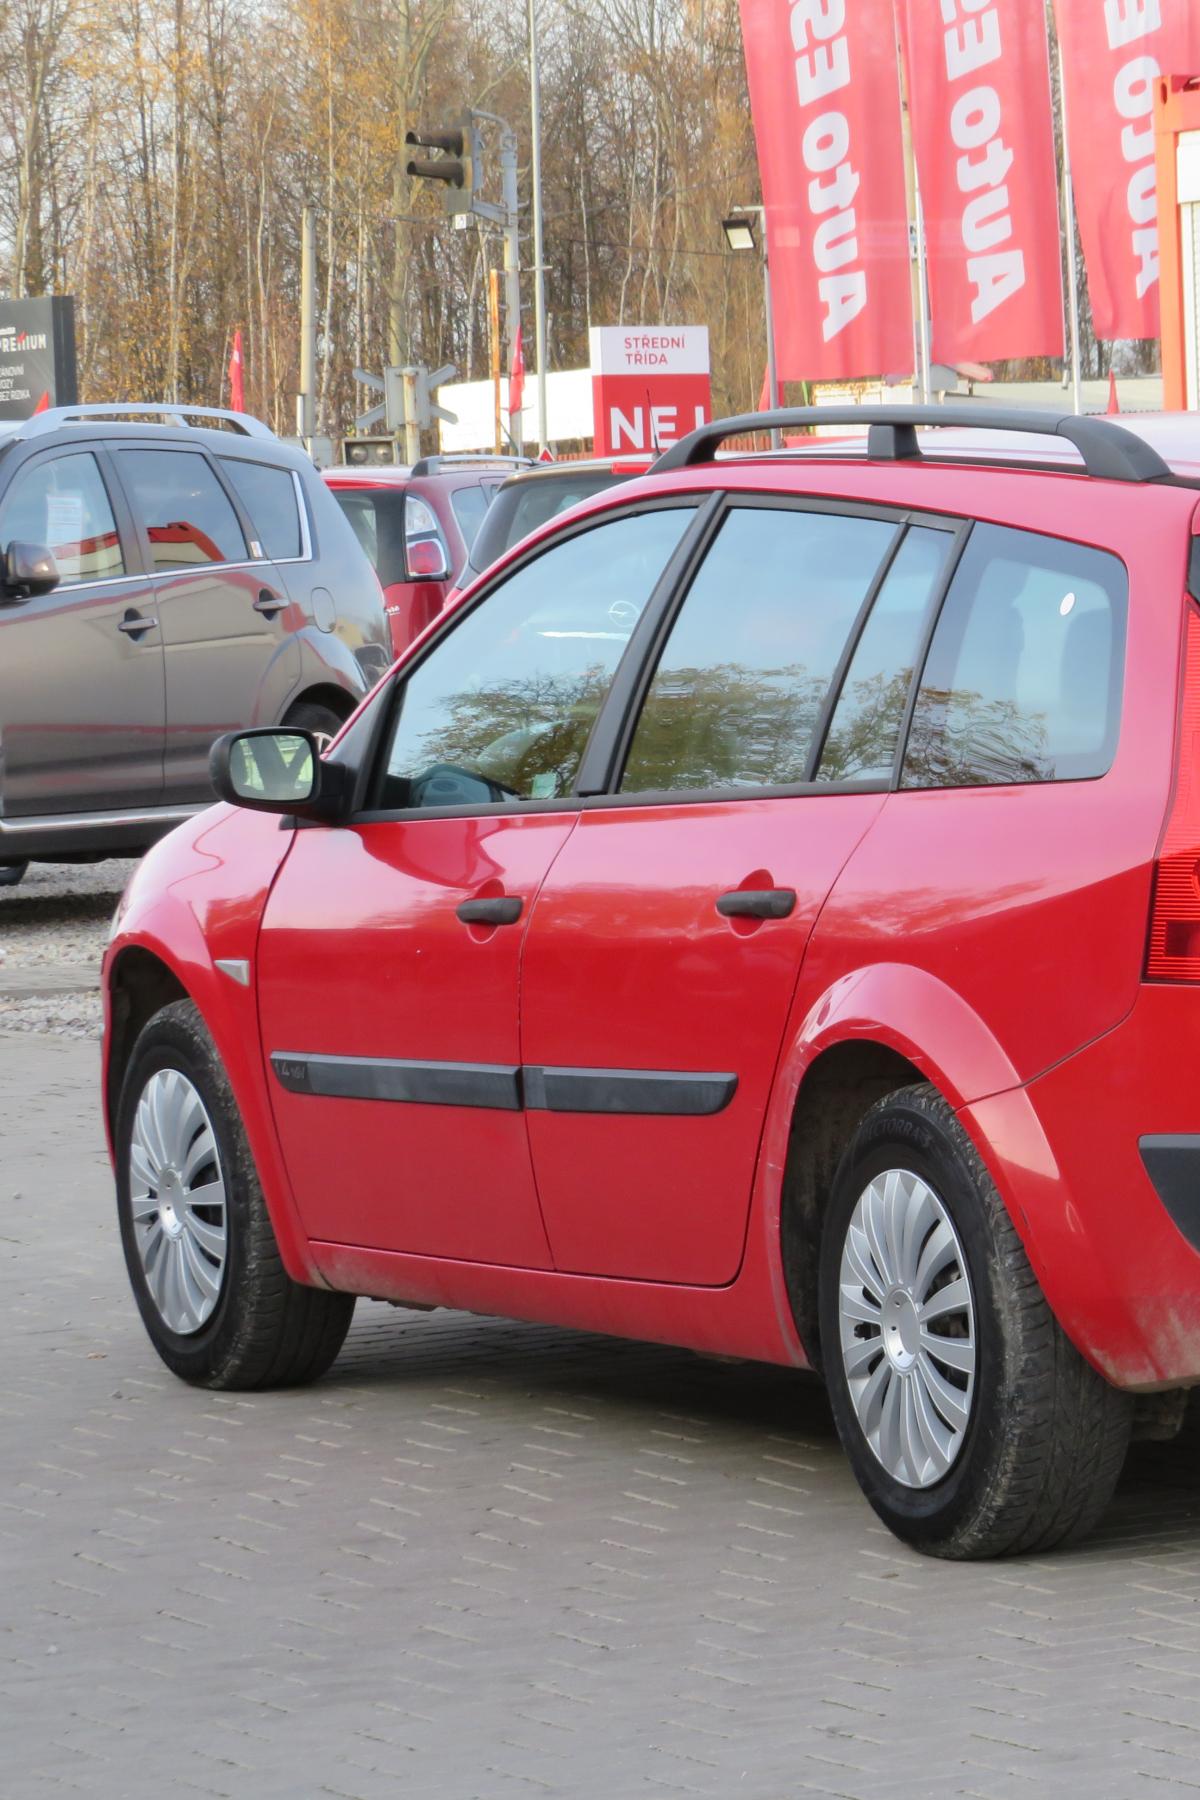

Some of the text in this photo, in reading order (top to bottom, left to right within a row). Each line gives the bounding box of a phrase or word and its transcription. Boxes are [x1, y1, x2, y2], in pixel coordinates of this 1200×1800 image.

[0, 334, 47, 353] REMIUM
[624, 334, 685, 349] STŘEDNÍ
[625, 350, 668, 365] TŘÍDA
